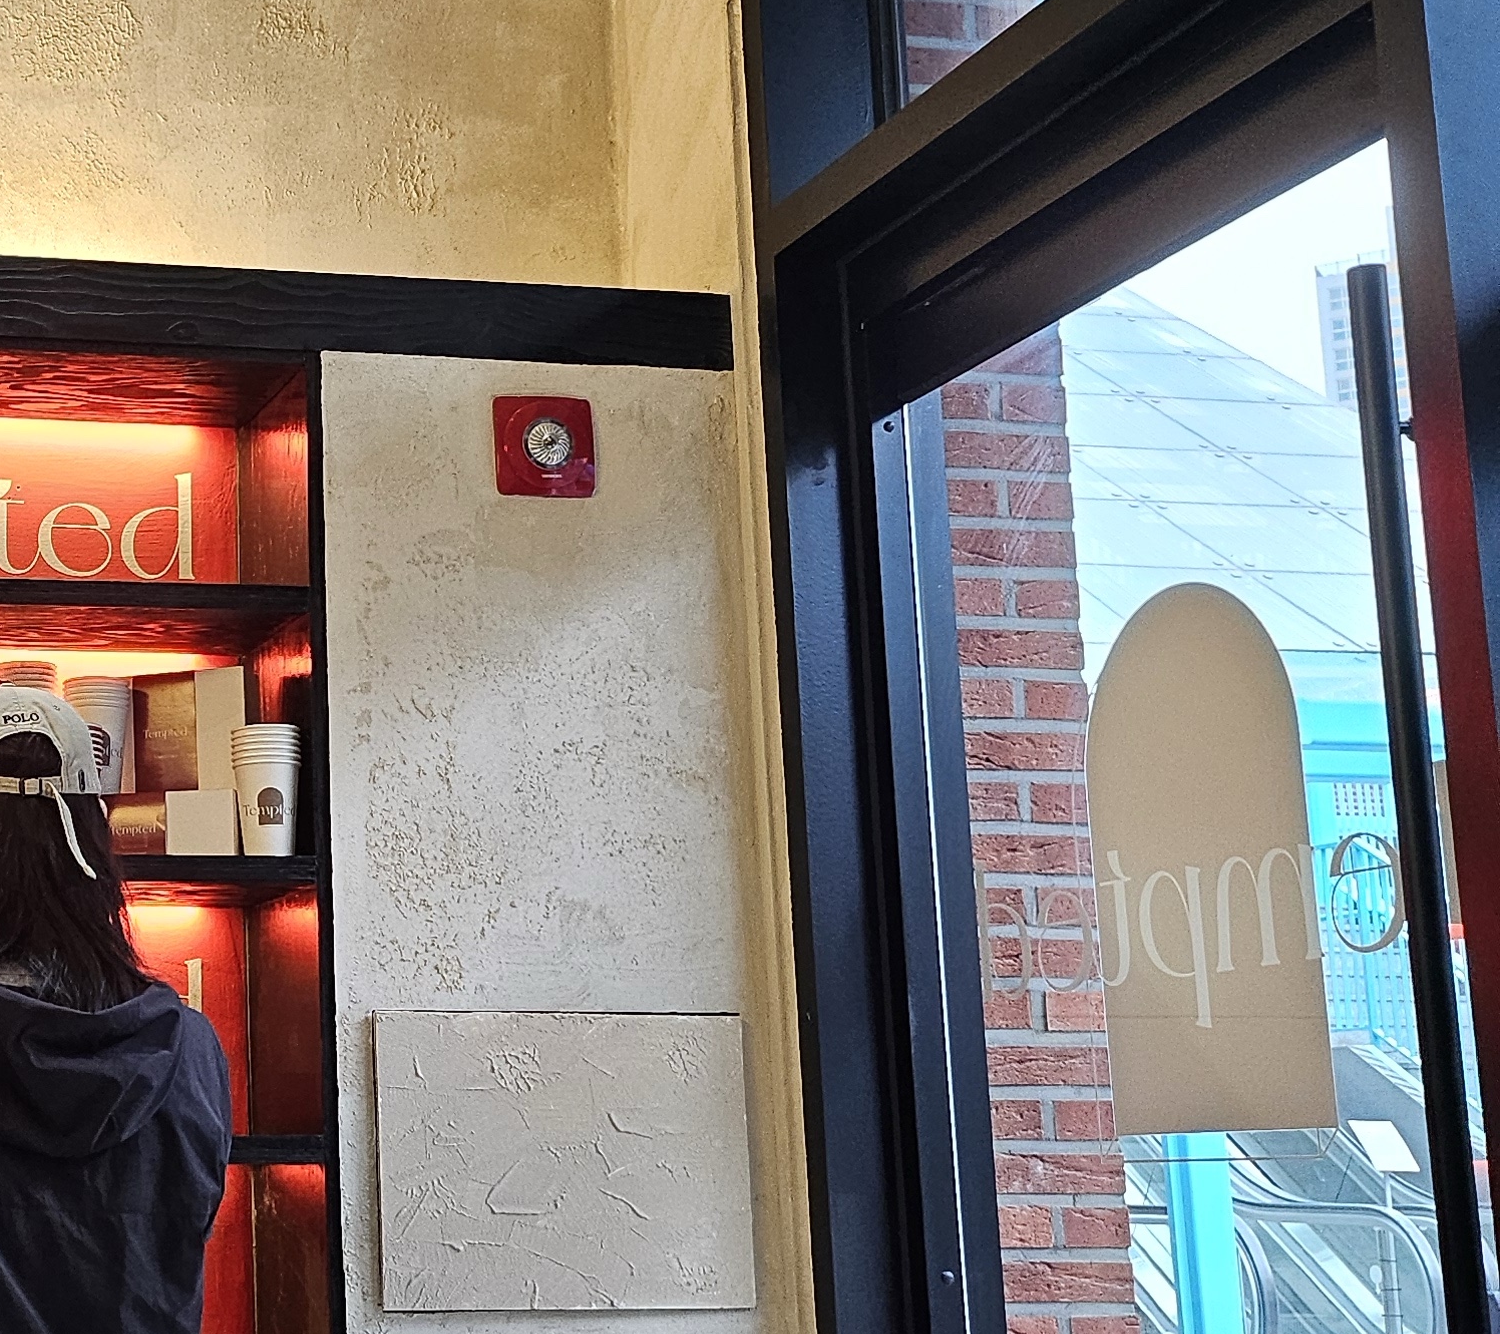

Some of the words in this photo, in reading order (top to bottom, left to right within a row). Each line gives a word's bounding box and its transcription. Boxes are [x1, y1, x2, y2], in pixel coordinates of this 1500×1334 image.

[2, 712, 40, 724] POLO
[142, 727, 188, 740] Tempted
[110, 822, 157, 837] Tempted
